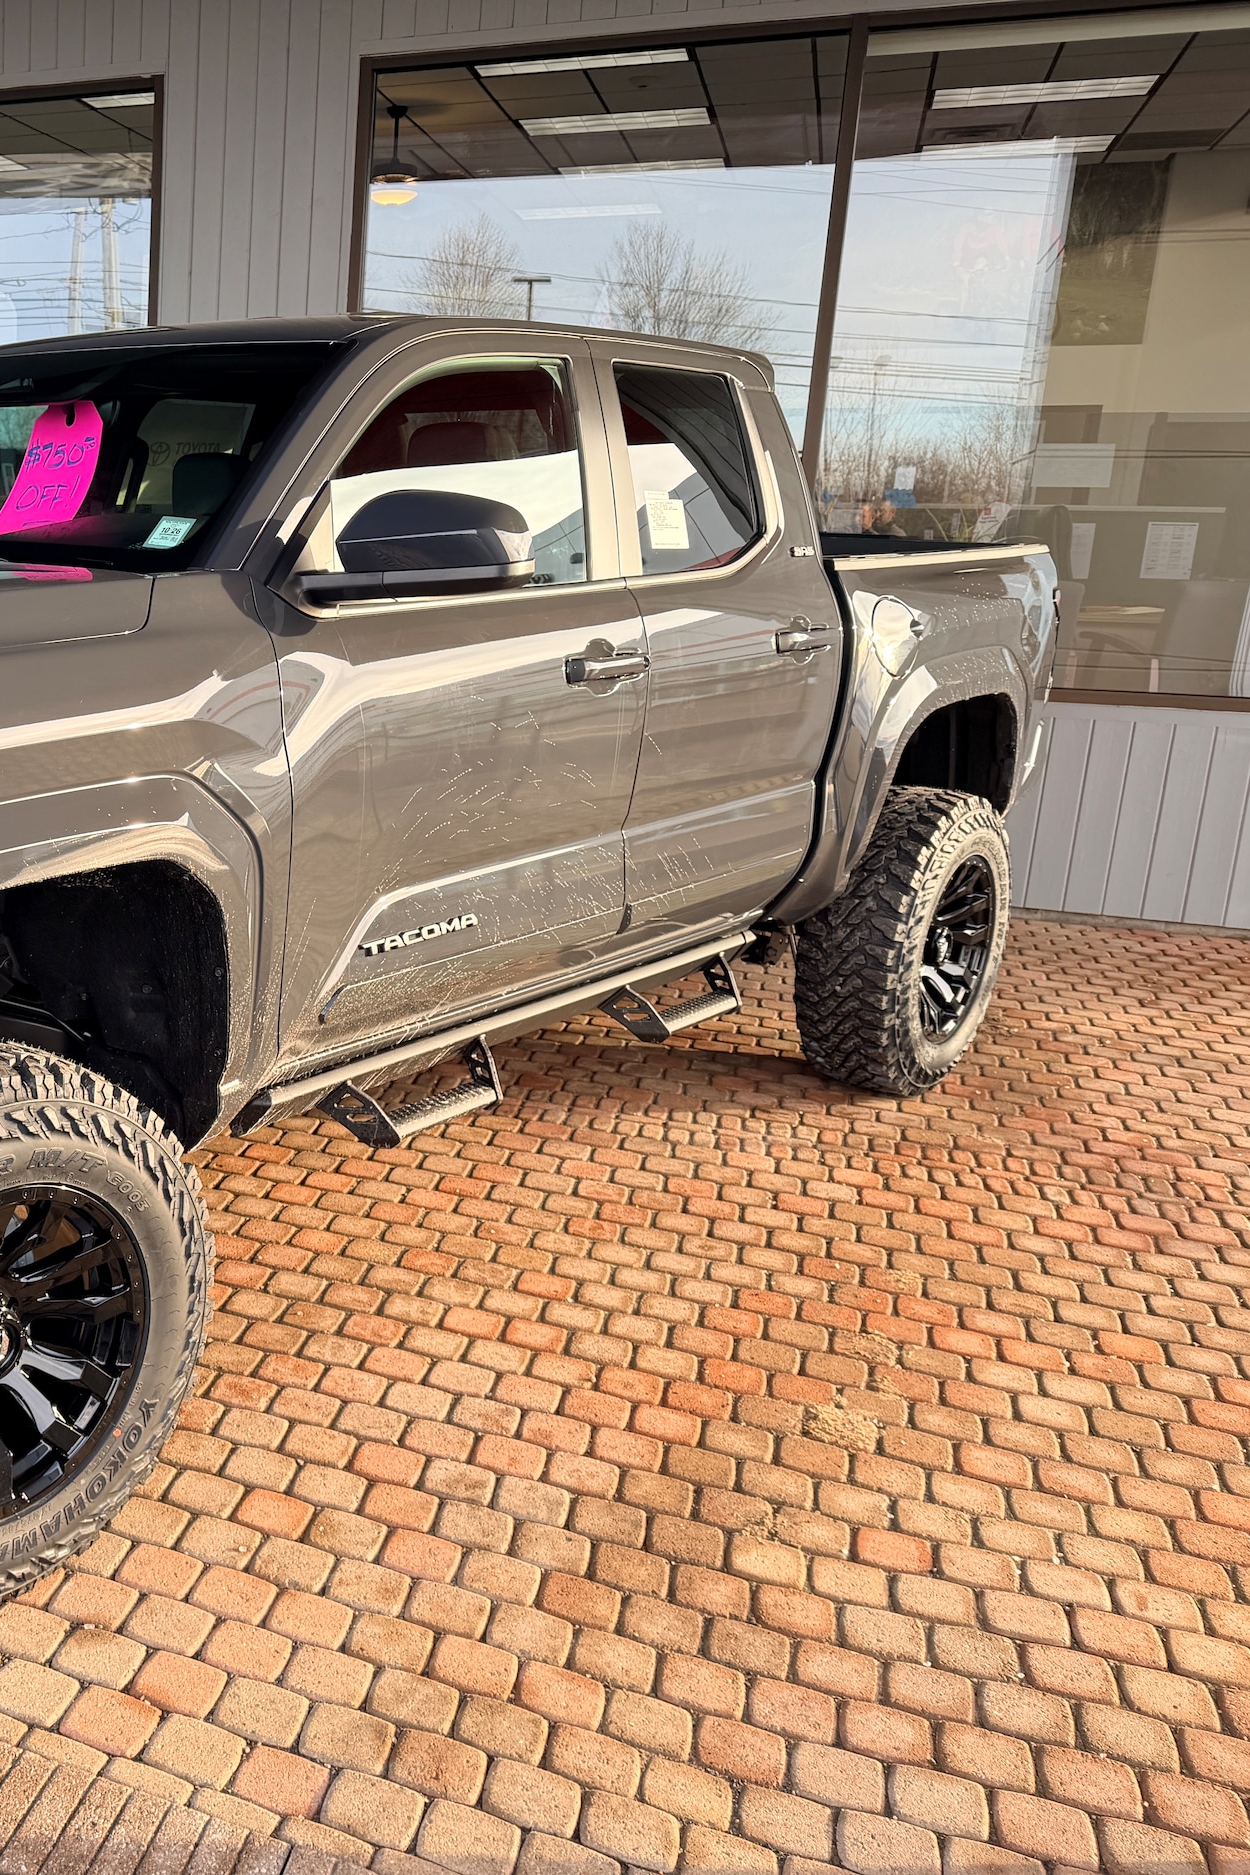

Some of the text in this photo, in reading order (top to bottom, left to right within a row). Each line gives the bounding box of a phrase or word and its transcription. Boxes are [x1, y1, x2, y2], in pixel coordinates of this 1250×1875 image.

[175, 442, 221, 456] TOYOTA
[15, 474, 81, 511] OFF!
[358, 912, 479, 957] TACOMA
